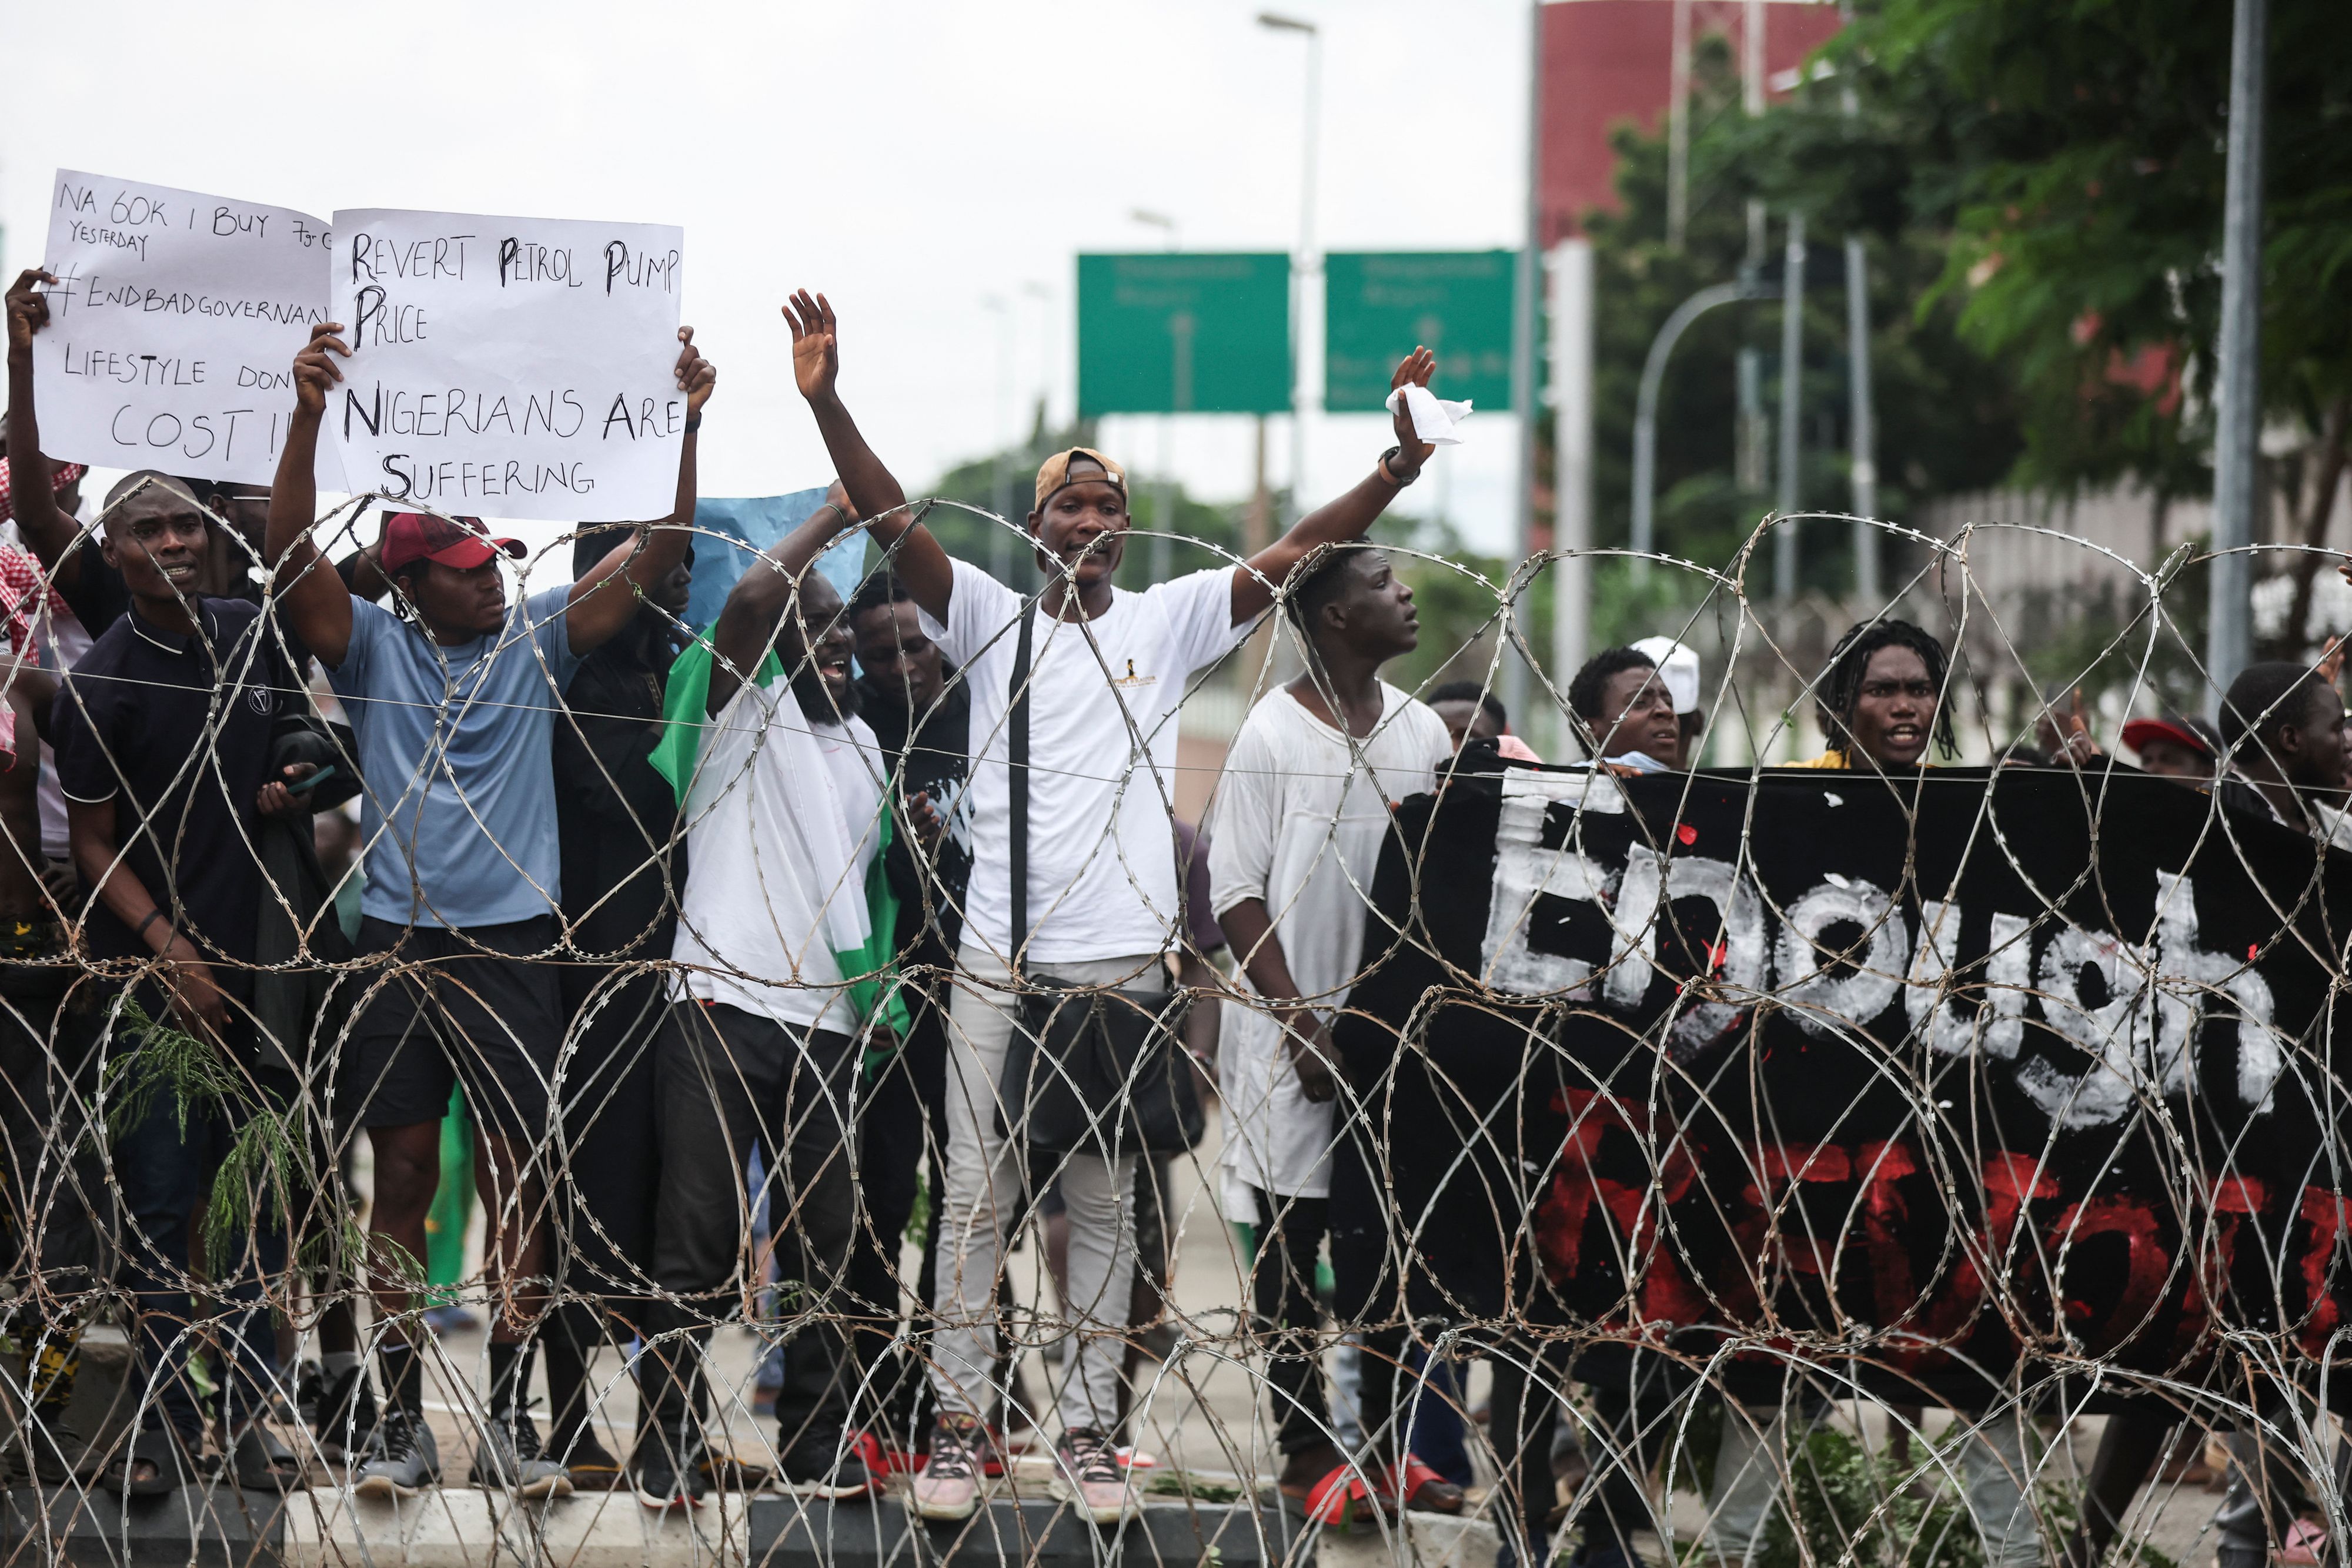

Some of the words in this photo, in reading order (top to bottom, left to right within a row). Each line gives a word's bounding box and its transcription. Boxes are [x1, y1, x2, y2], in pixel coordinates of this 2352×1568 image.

[60, 183, 96, 213] NA
[111, 190, 167, 226] 60K
[213, 207, 269, 238] BUY
[70, 220, 148, 262] YESTERDAY
[352, 233, 476, 285] REVERT
[499, 237, 582, 287] PETROL
[604, 240, 679, 297] PUMP
[354, 285, 427, 352] PRICE
[65, 343, 205, 385] LIFESTYLE
[345, 380, 583, 443] NIGERIANS
[603, 393, 681, 441] ARE
[379, 454, 594, 501] SUFFERING
